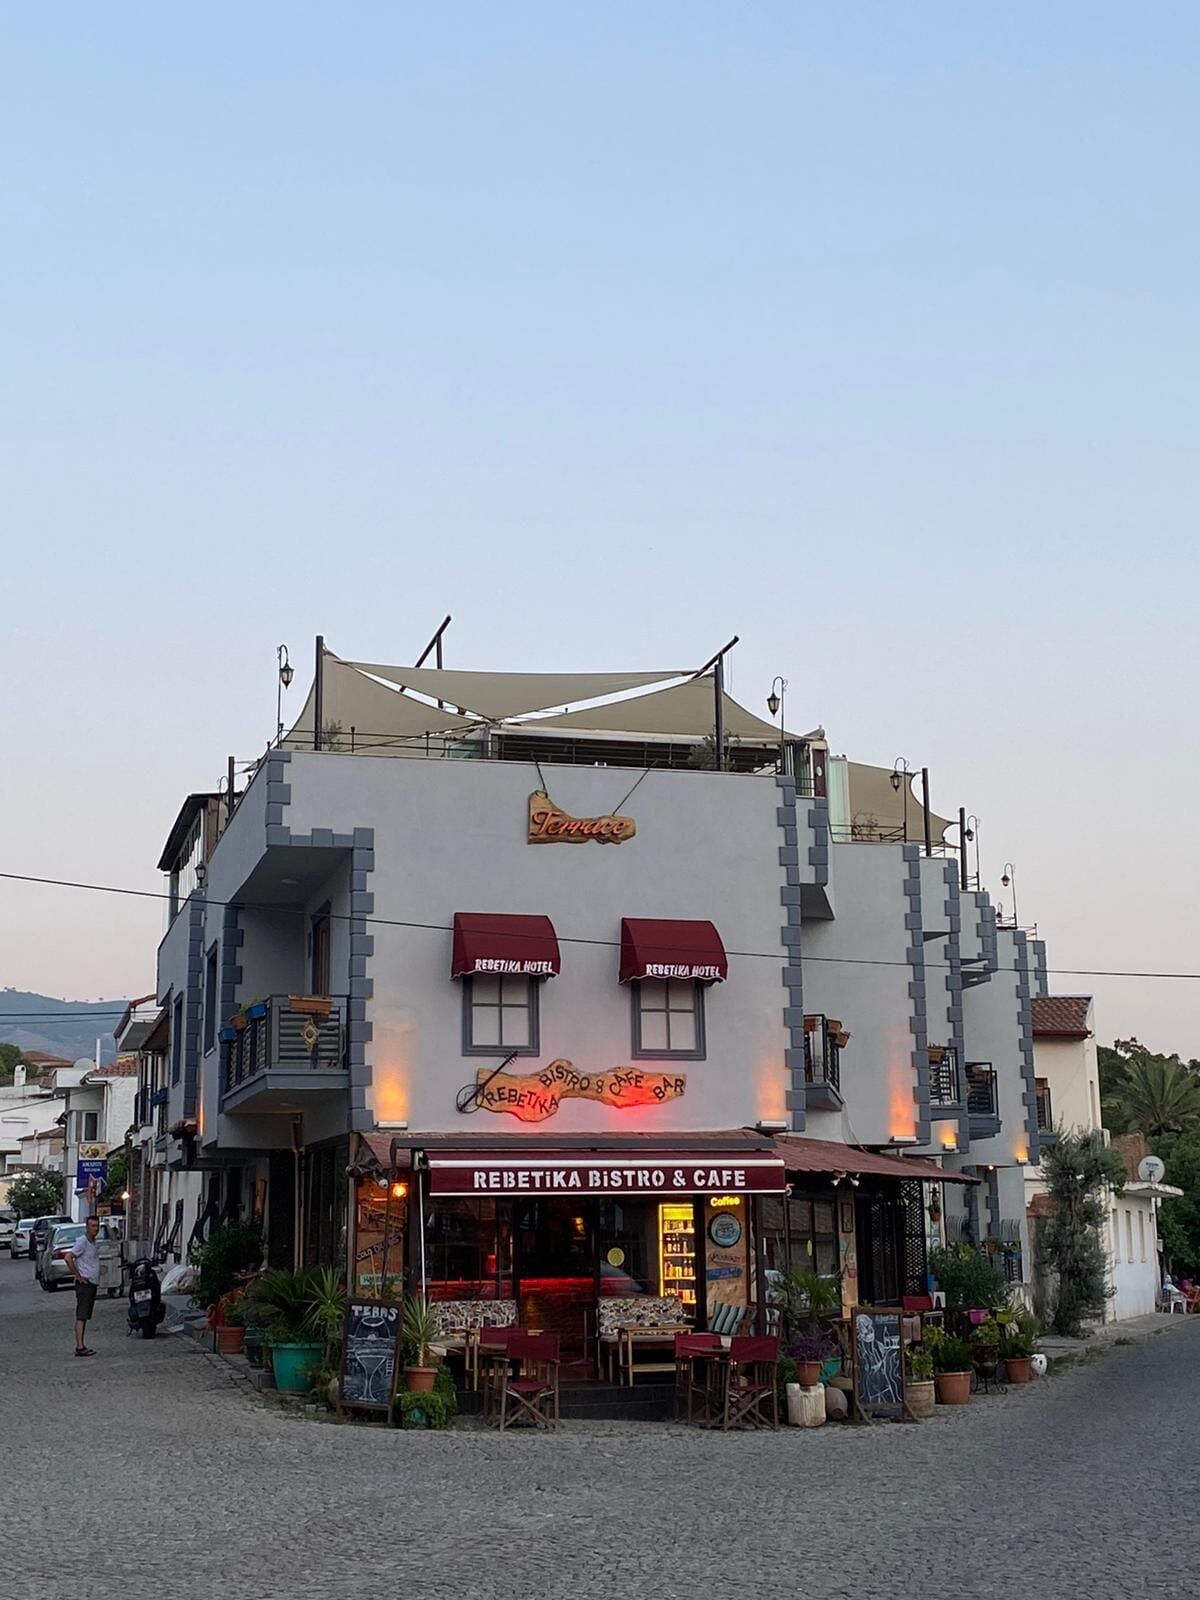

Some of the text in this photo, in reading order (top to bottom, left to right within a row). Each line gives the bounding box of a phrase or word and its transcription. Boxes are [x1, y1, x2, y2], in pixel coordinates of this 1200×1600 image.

[532, 811, 625, 834] Terrace
[524, 961, 553, 973] HOTEL
[692, 965, 720, 977] HOTEL
[485, 1087, 559, 1114] REBETIKA
[539, 1065, 590, 1092] BISTRO
[608, 1071, 644, 1096] CAFE
[652, 1076, 685, 1101] BAR
[672, 1170, 687, 1187] &
[693, 1170, 746, 1187] CAFE
[710, 1196, 741, 1207] Coffee
